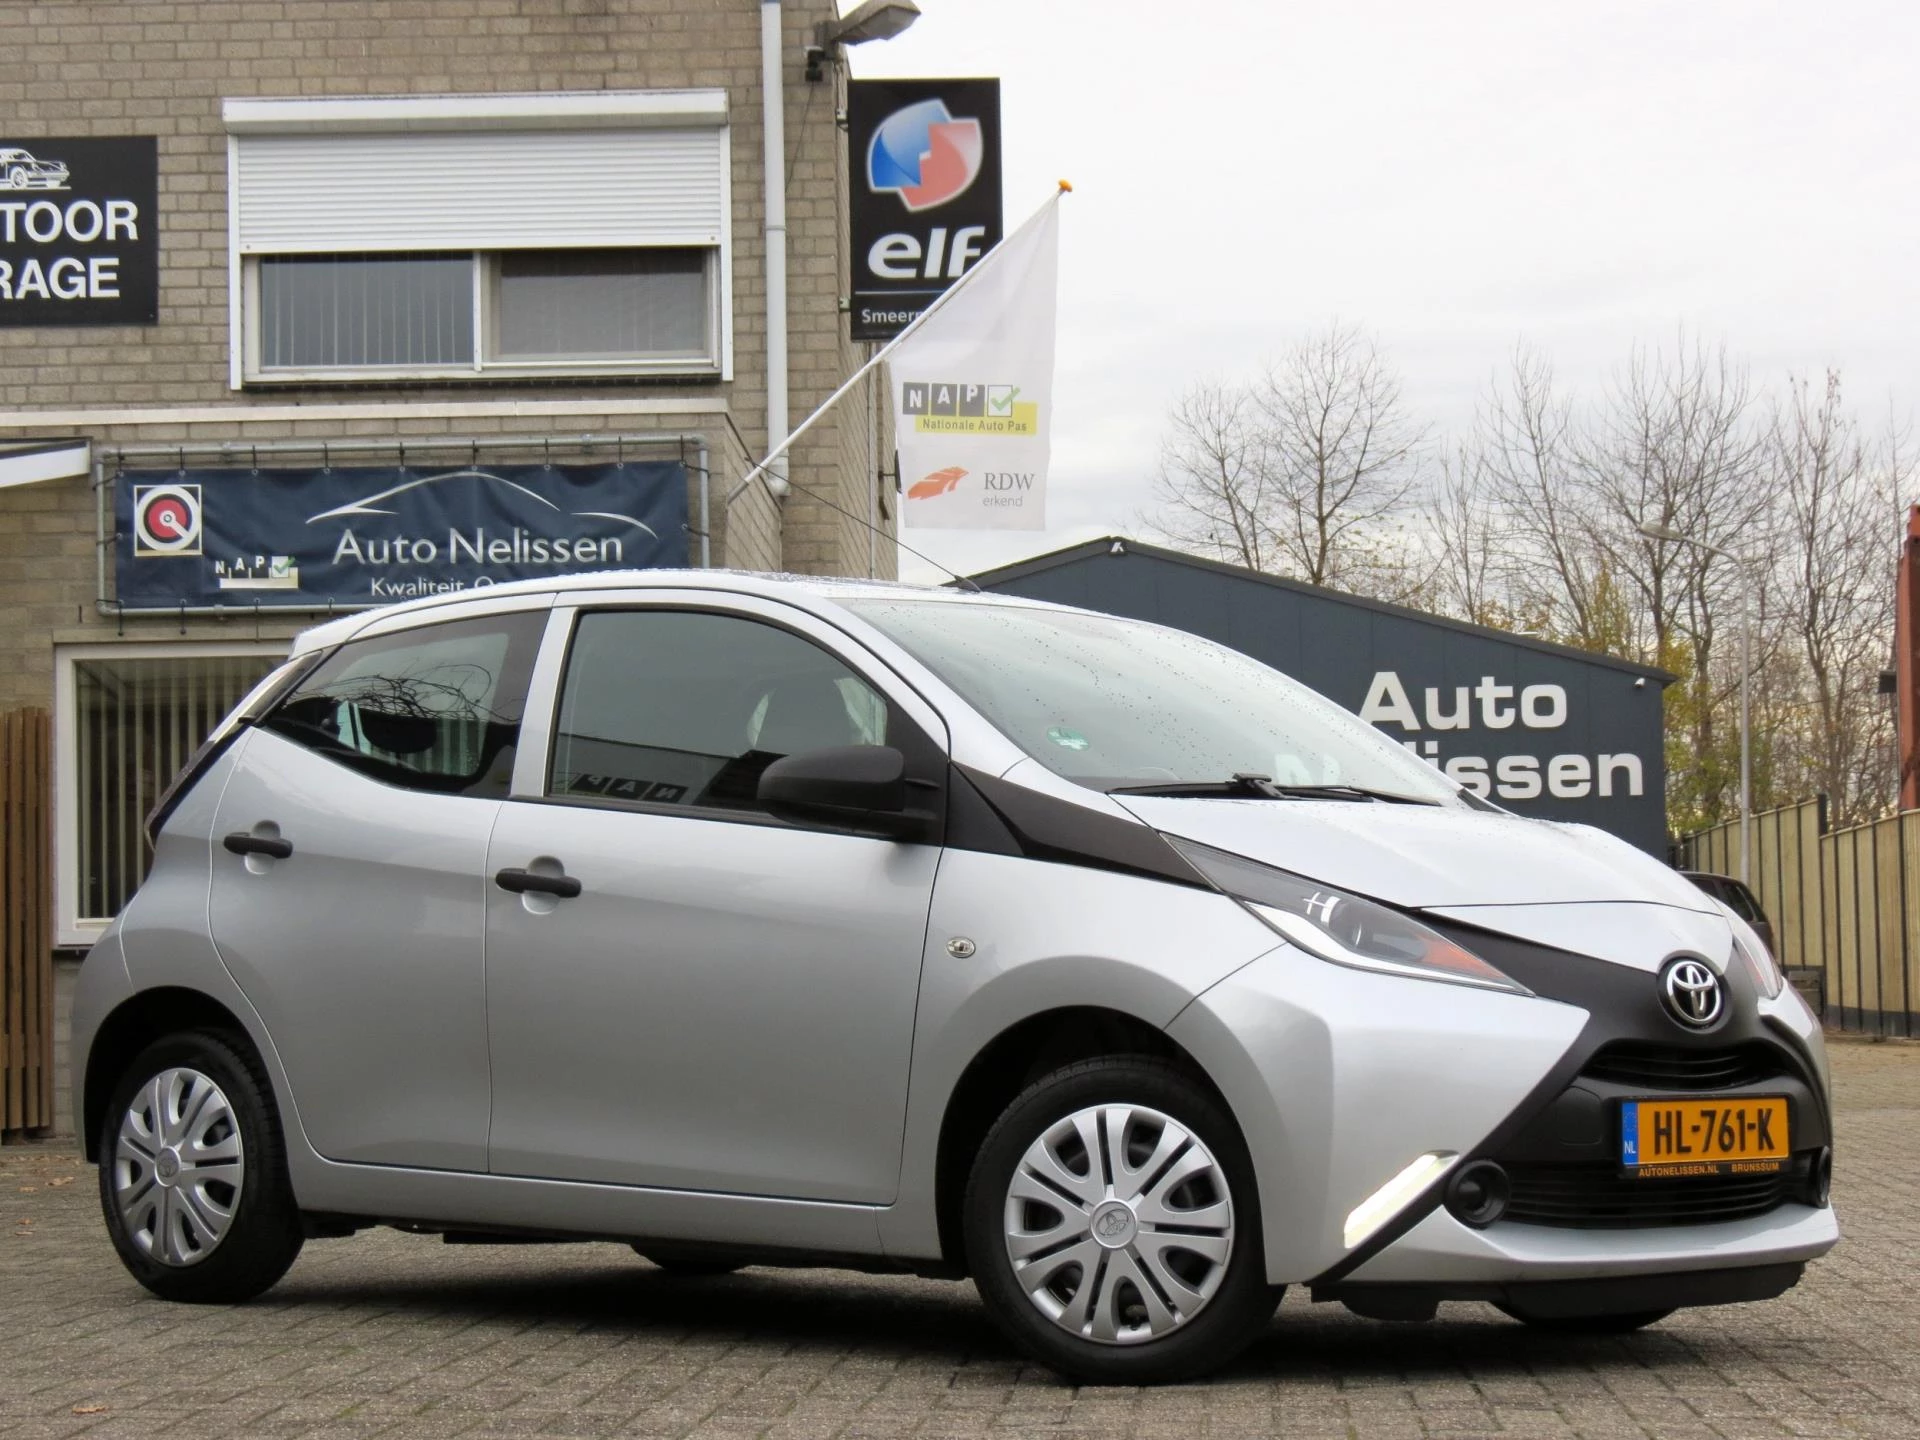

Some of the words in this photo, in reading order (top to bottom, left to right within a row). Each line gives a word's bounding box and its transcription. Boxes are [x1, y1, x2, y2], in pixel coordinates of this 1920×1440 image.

[868, 226, 985, 278] elf
[922, 418, 974, 430] Nationale
[978, 420, 1004, 431] Auto
[1007, 421, 1027, 431] Pas
[984, 472, 1035, 490] RDW
[982, 495, 1023, 507] erkend
[332, 529, 437, 565] Auto
[450, 528, 622, 564] Nelissen
[1358, 672, 1567, 730] Auto
[1654, 1108, 1775, 1154] HL-761-K
[1624, 1141, 1636, 1154] NL
[1639, 1165, 1719, 1177] AUTONELISSEN.NL
[1731, 1162, 1780, 1173] BRUNSSUM
